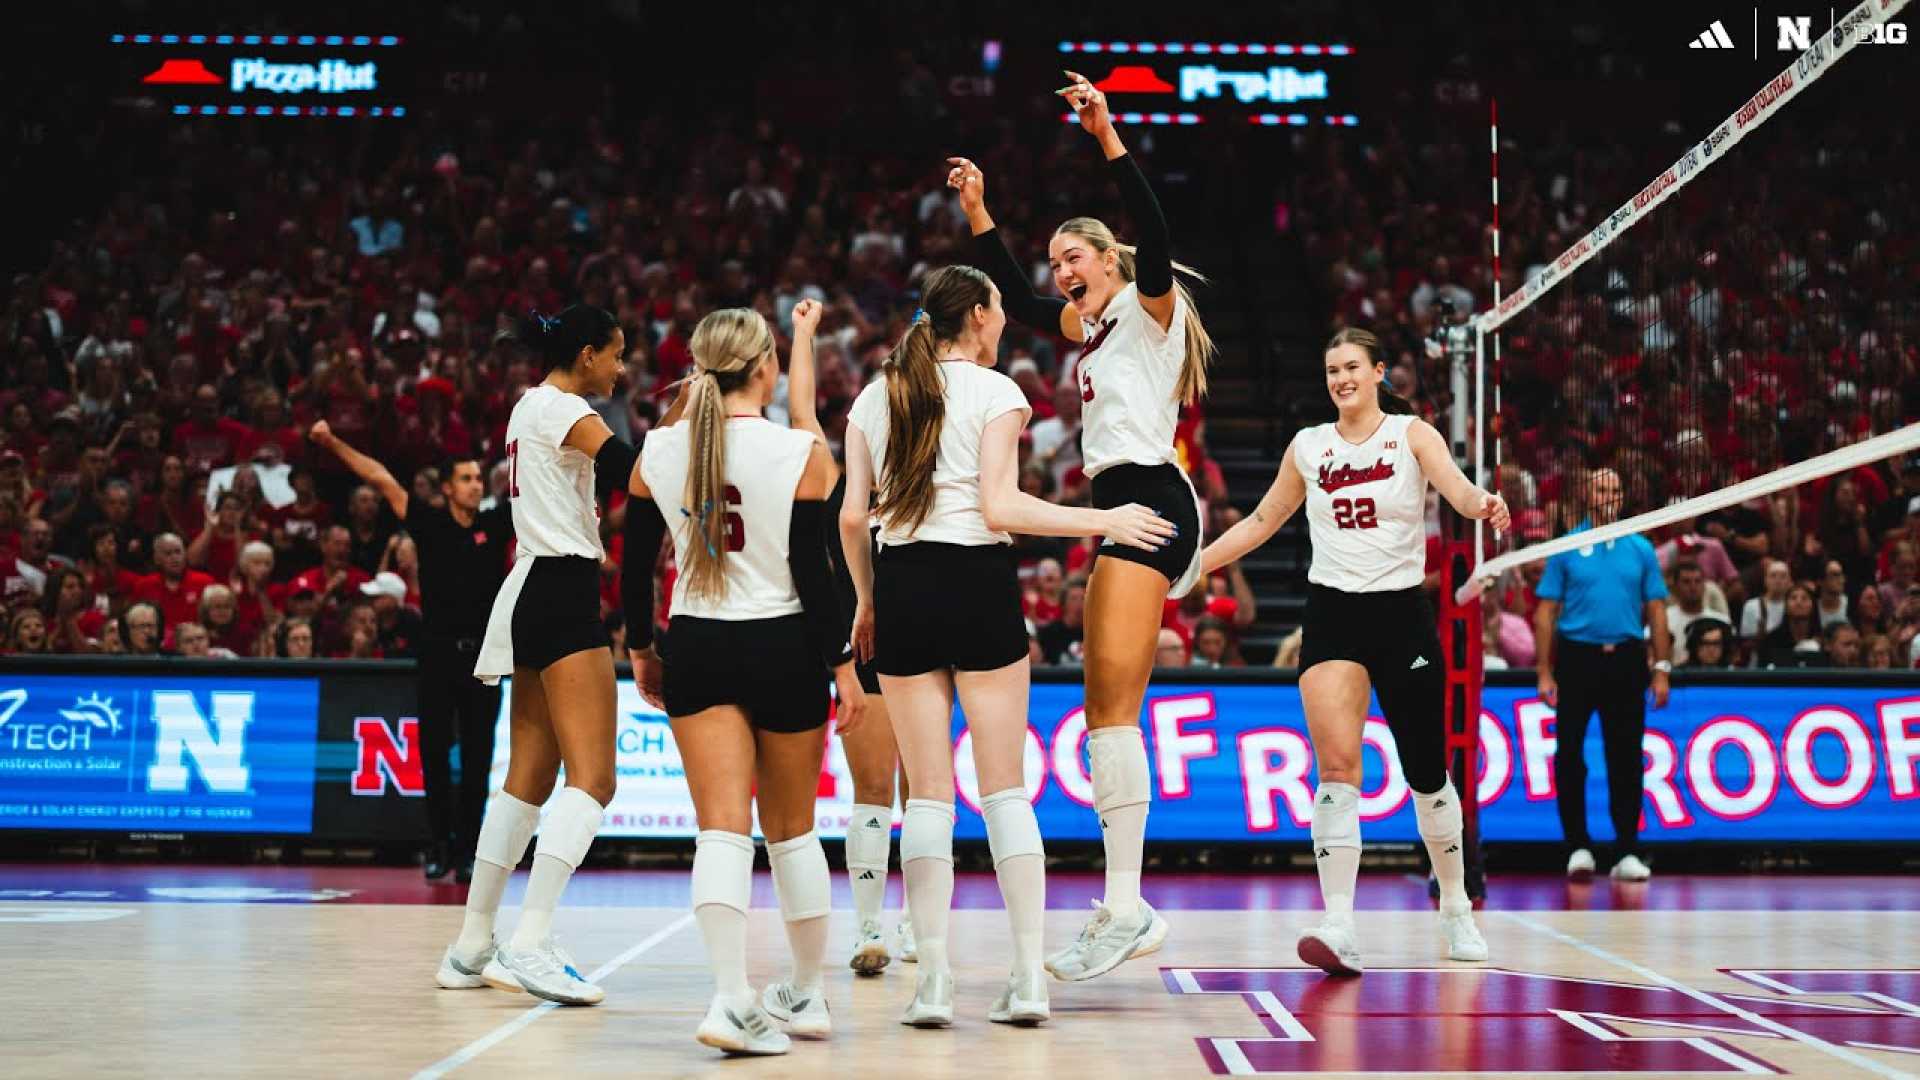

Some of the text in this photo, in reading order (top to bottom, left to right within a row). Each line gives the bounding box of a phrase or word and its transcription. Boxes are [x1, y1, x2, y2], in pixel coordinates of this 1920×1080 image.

[319, 58, 377, 93] Hut
[1332, 498, 1378, 528] 22
[8, 724, 91, 750] TECH
[147, 689, 255, 793] N
[351, 716, 426, 797] N
